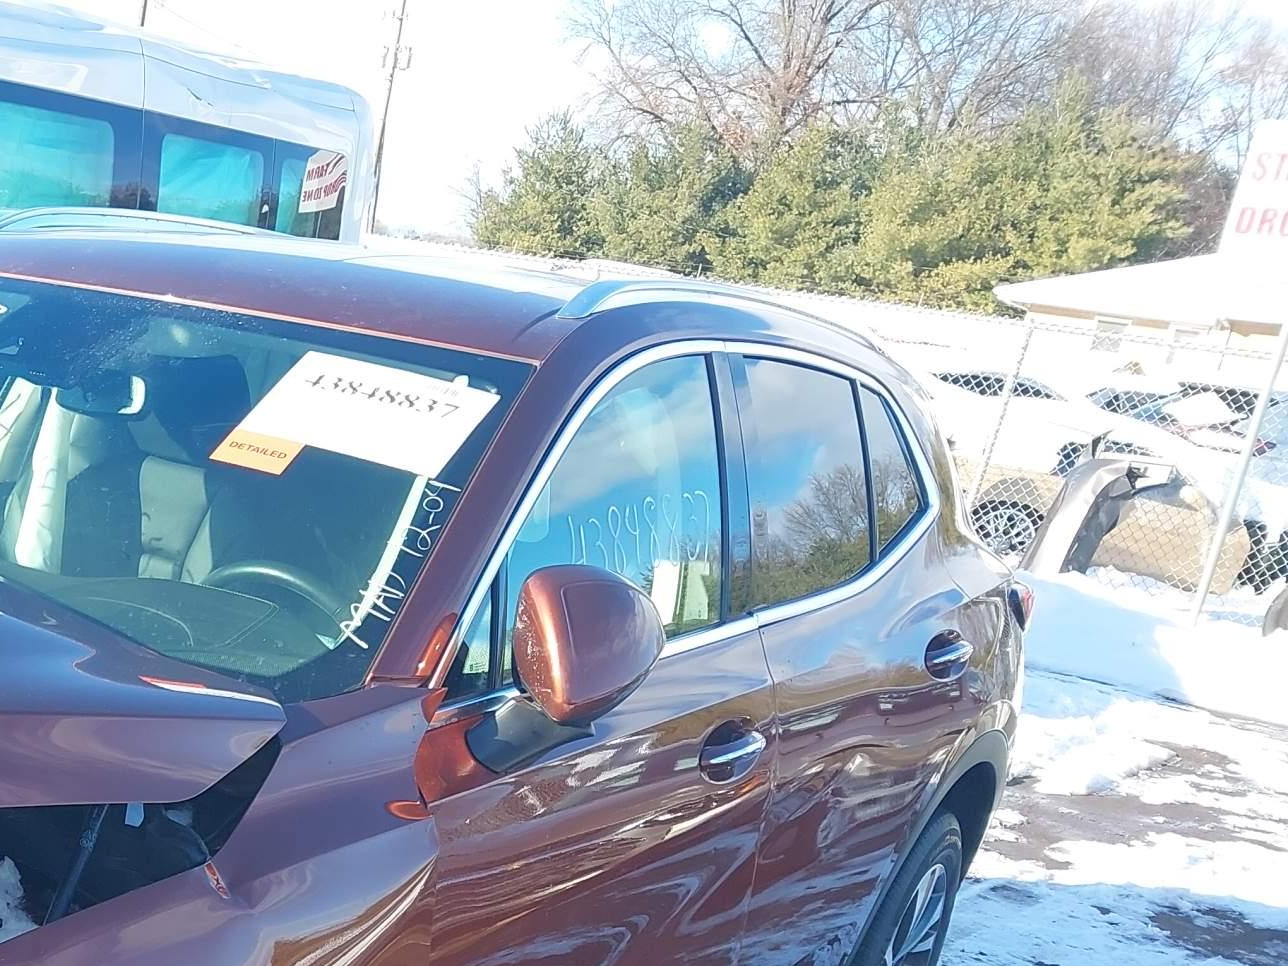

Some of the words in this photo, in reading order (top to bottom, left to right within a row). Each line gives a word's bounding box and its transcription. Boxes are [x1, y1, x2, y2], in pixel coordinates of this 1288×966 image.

[1253, 152, 1288, 182] ST
[305, 373, 460, 420] 43848837
[229, 440, 288, 461] DETAILED
[399, 480, 462, 558] 12-04
